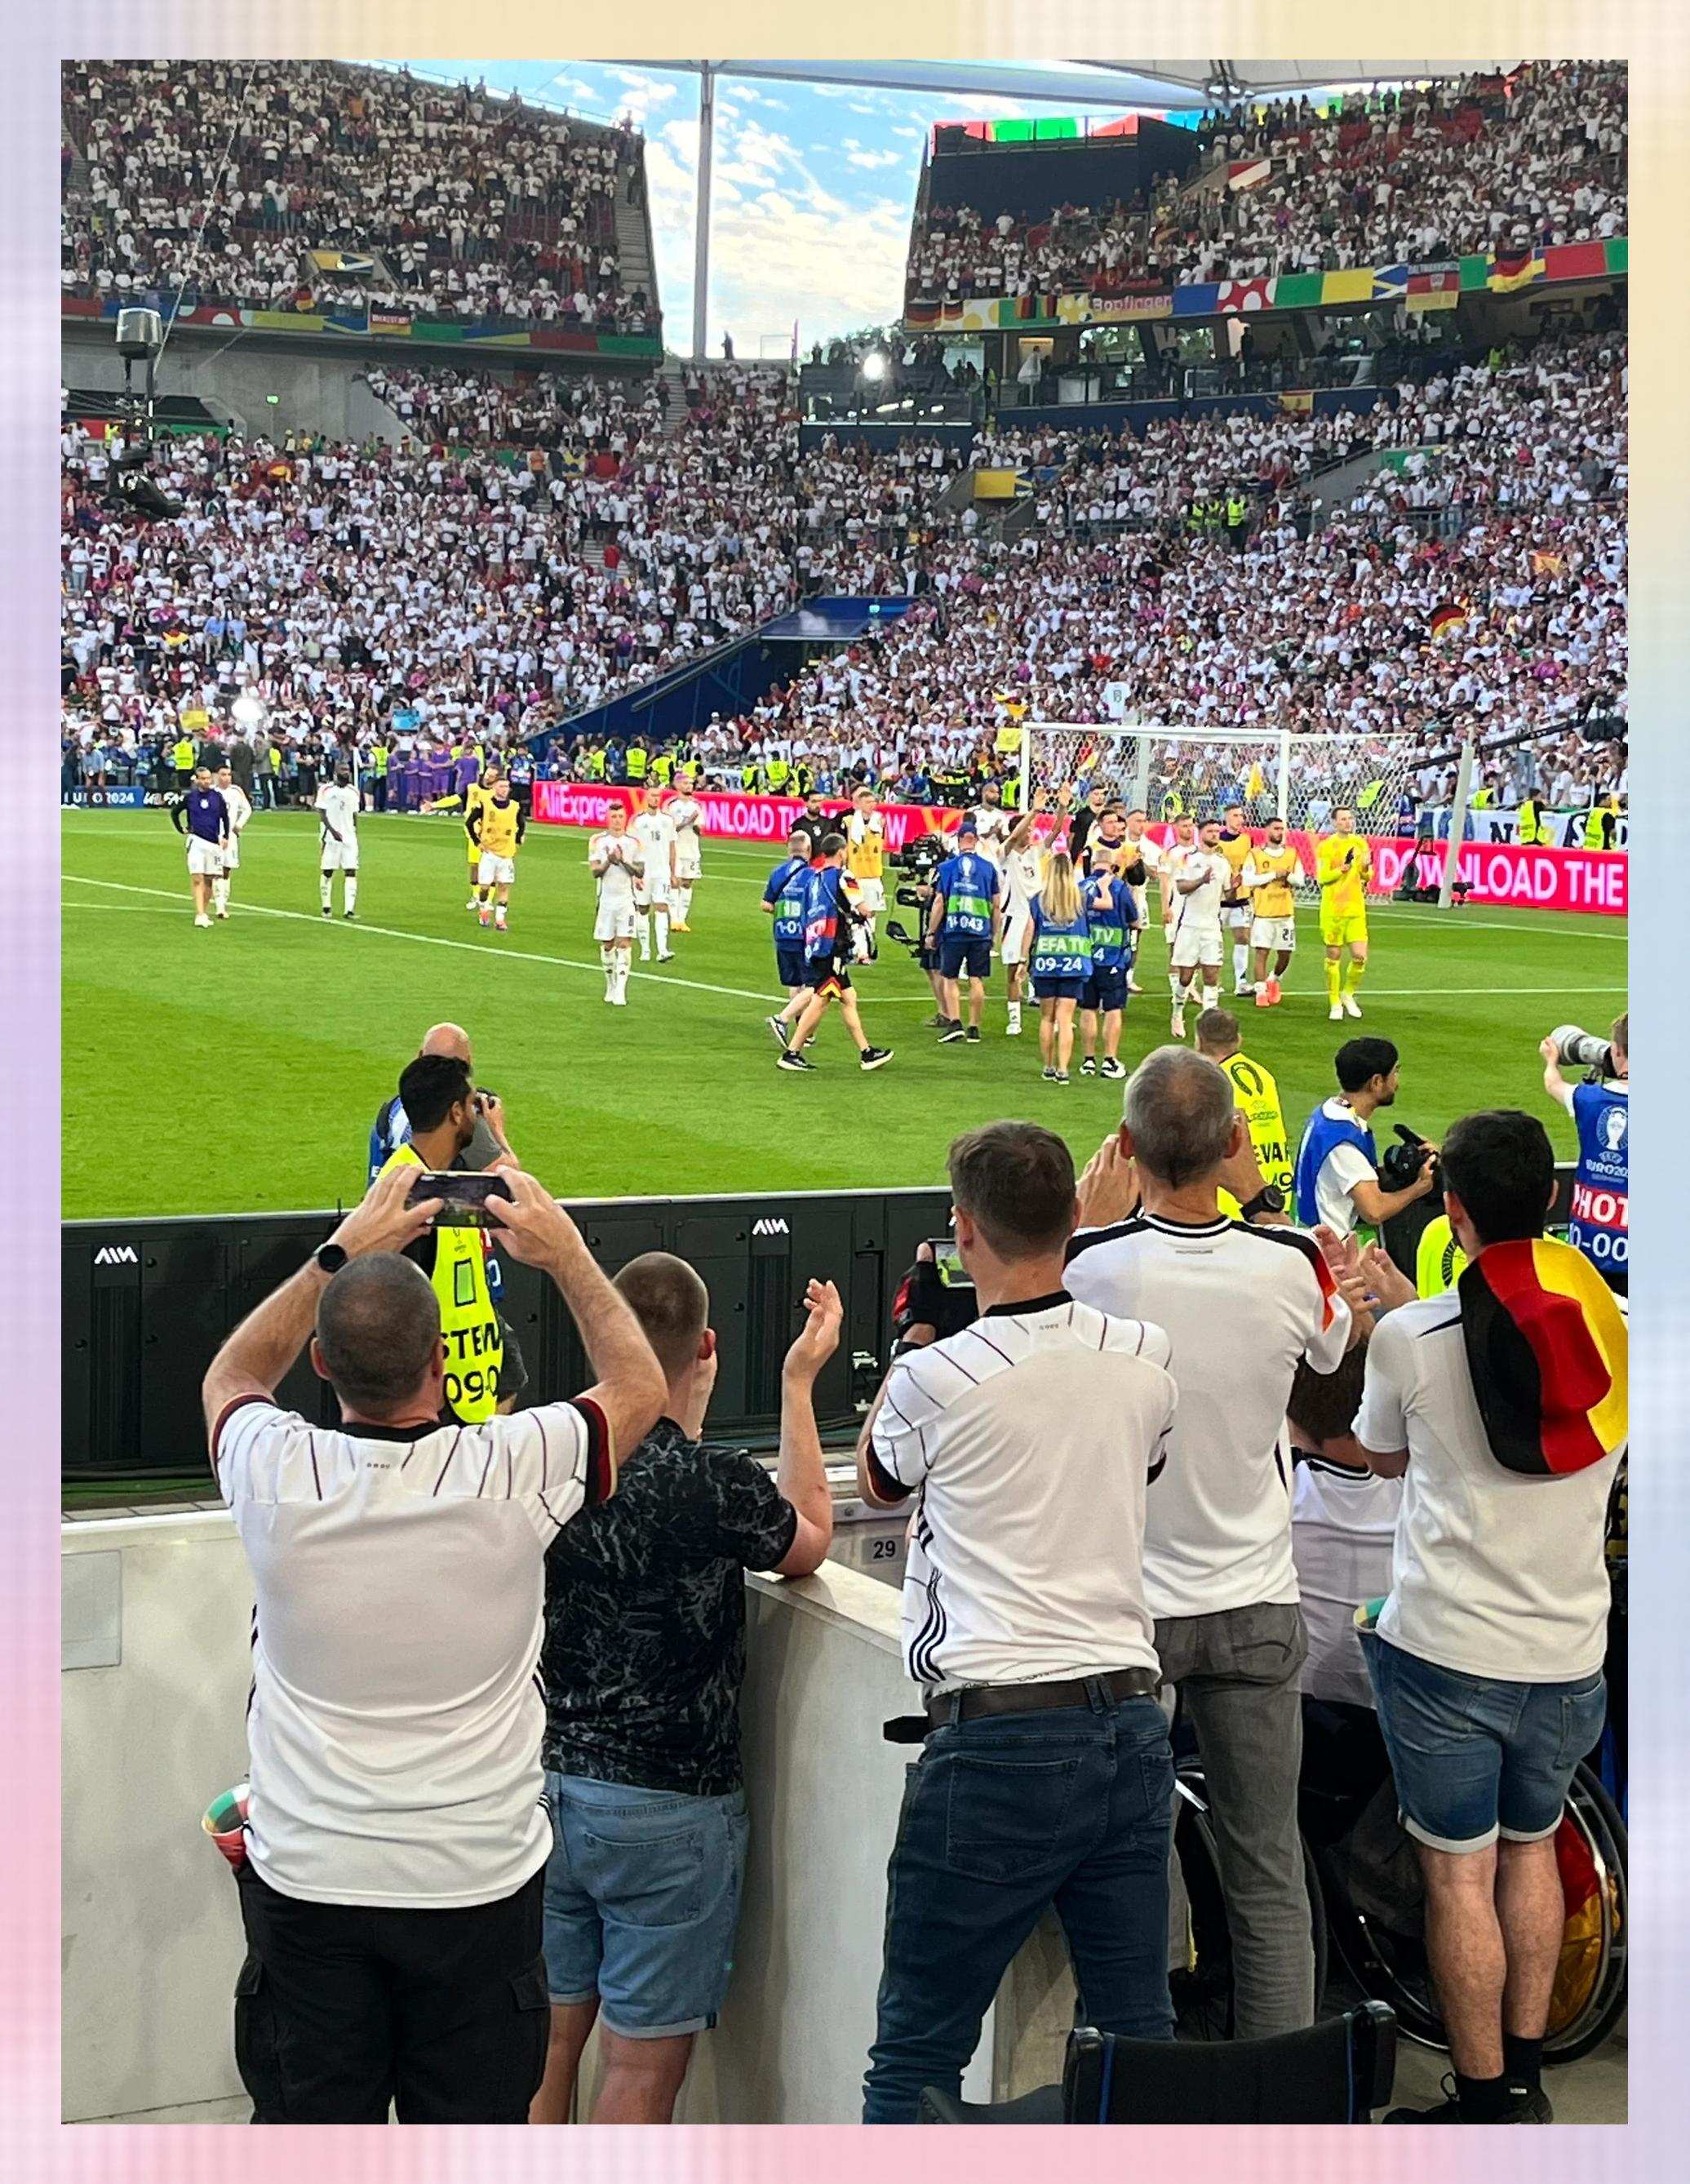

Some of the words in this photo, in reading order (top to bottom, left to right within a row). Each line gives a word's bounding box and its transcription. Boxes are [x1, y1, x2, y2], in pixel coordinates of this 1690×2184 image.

[539, 783, 623, 827] AliExpre
[1564, 860, 1625, 907] THE
[1036, 936, 1067, 952] EFA
[1035, 957, 1083, 972] 09-24
[873, 1540, 895, 1559] 29
